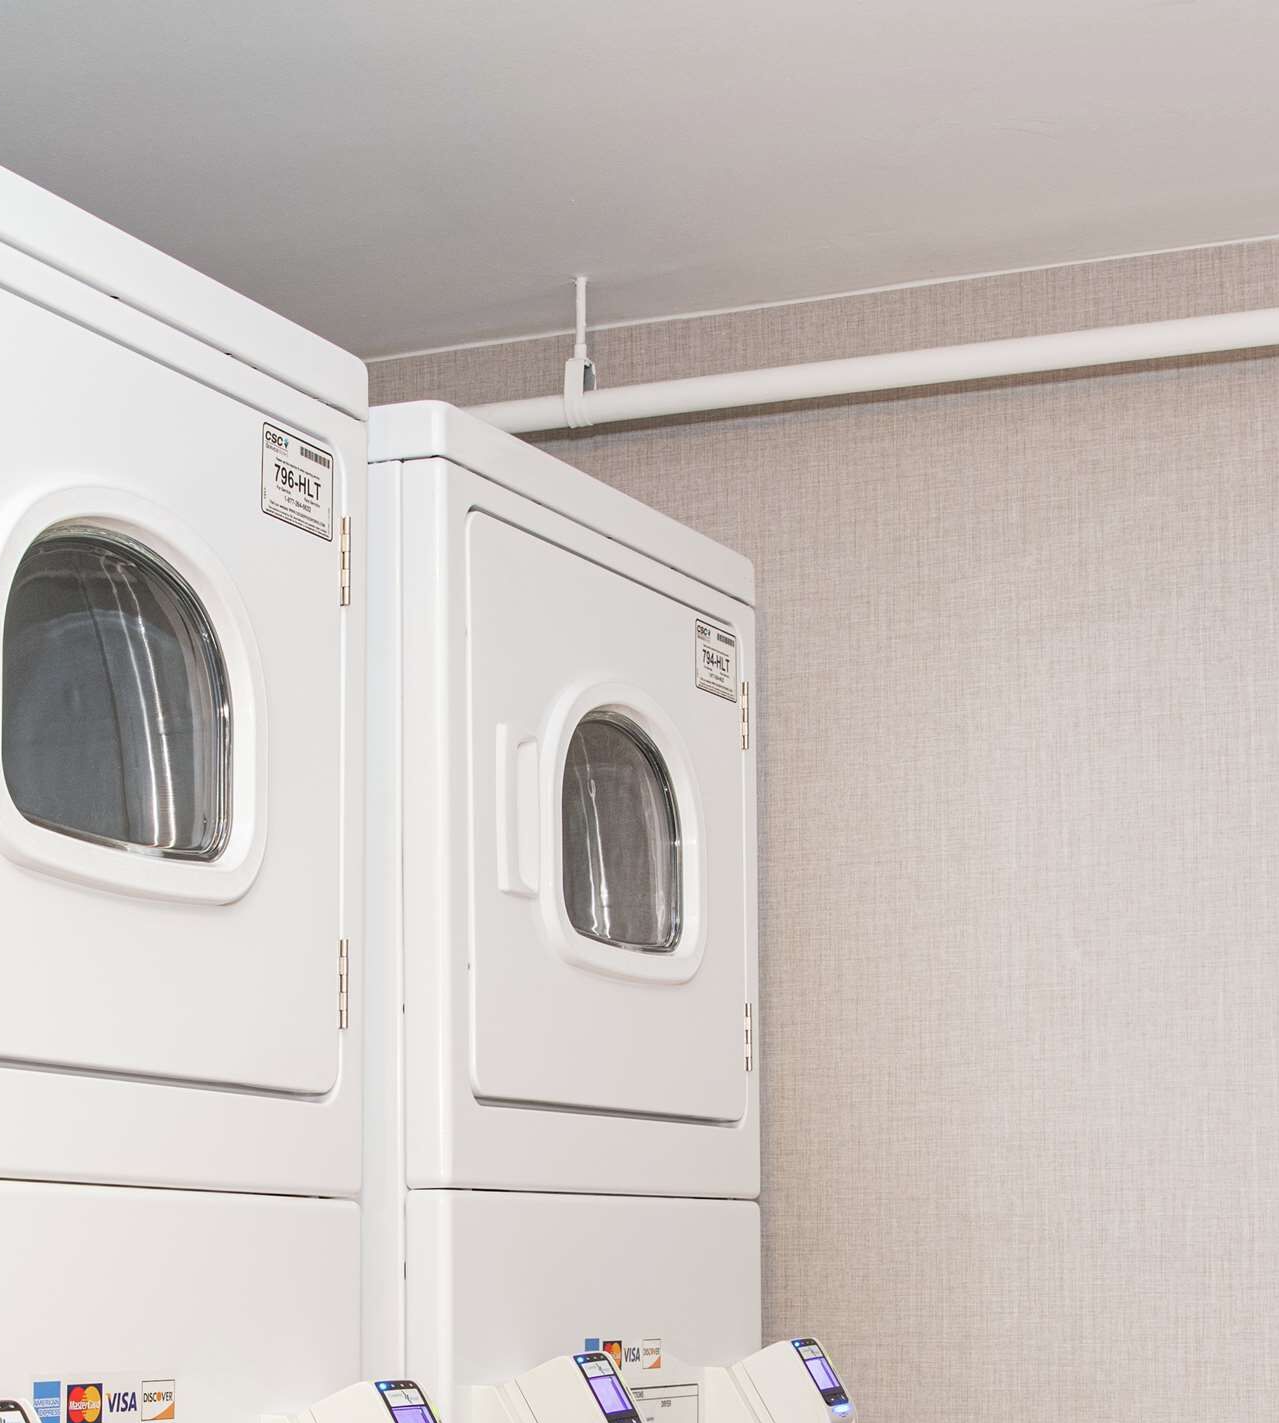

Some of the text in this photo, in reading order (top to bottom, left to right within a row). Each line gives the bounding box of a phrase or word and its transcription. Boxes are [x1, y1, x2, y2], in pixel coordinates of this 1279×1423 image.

[265, 431, 283, 446] CSC
[274, 464, 321, 500] 796-HLT
[624, 1348, 640, 1362] VISA
[69, 1399, 100, 1410] MasterCard
[107, 1392, 137, 1413] VISA
[143, 1392, 173, 1403] DISCOVER
